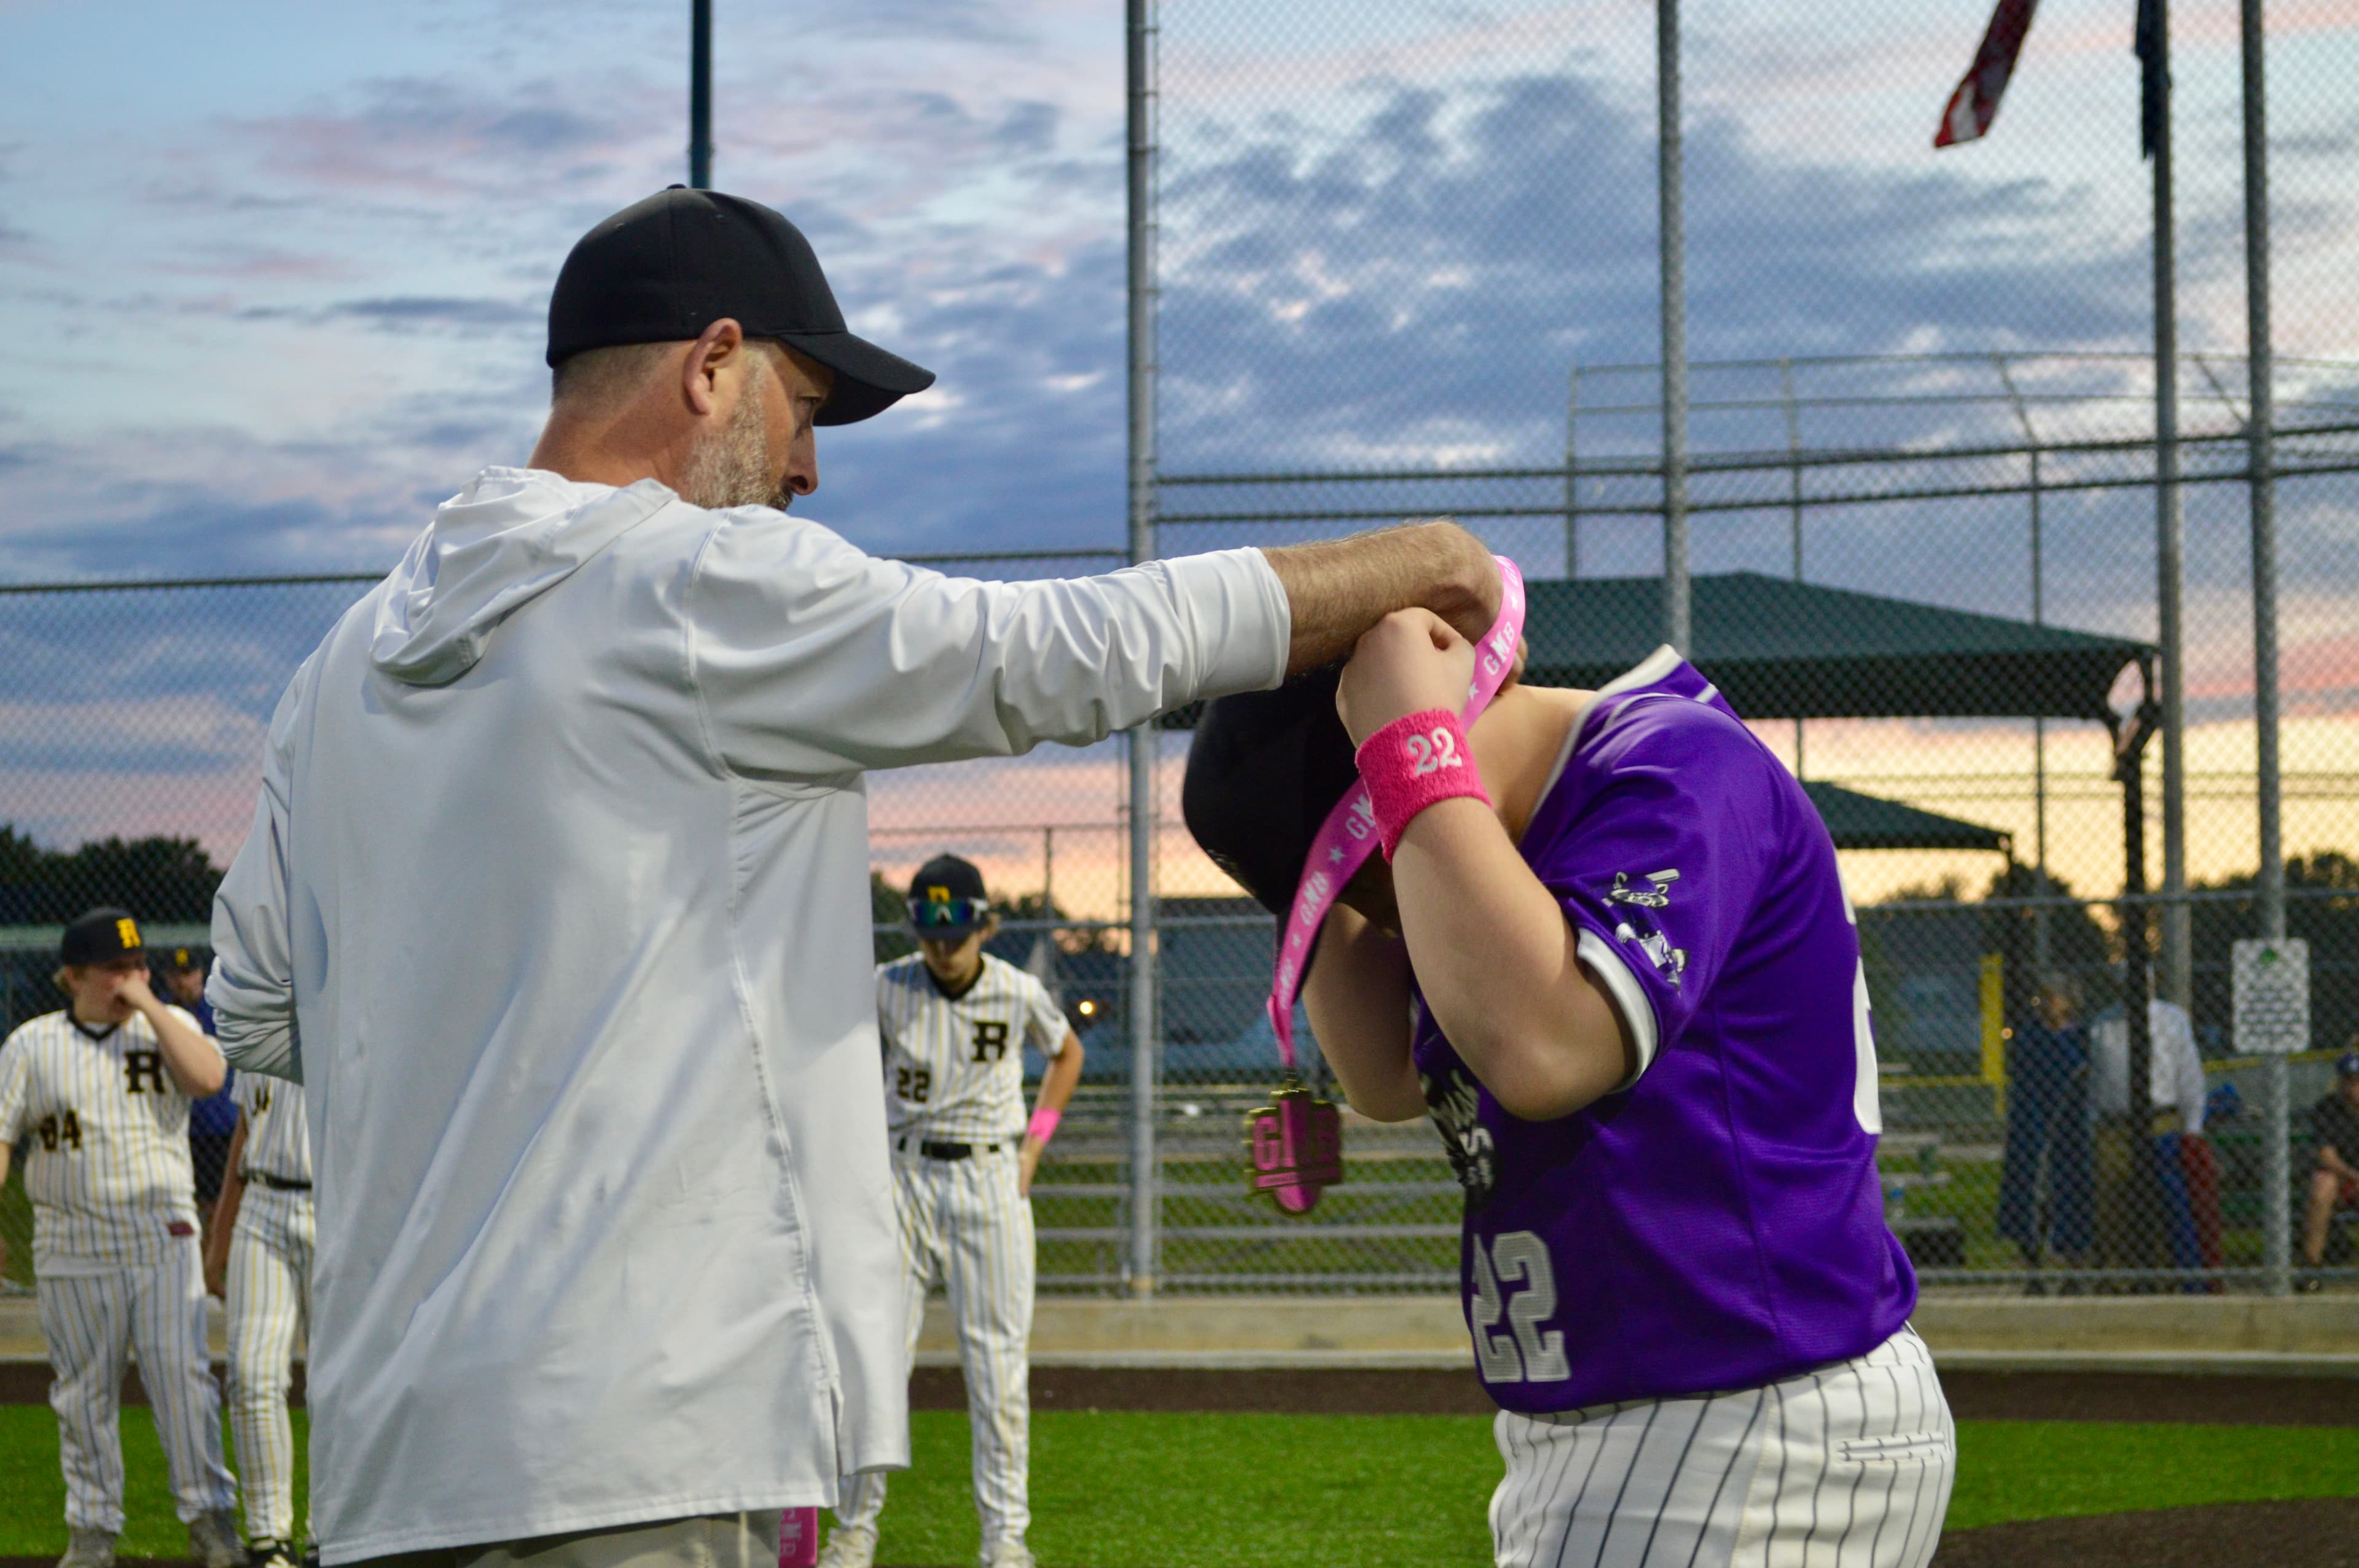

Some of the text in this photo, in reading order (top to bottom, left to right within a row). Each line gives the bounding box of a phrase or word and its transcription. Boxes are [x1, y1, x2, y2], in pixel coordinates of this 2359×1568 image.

[1483, 622, 1515, 676] GMB
[1407, 727, 1462, 777] 22
[1299, 870, 1329, 926] GMB
[116, 918, 141, 948] R
[971, 1020, 1008, 1063] R
[124, 1050, 165, 1094] R
[897, 1066, 930, 1103] 22
[1472, 1230, 1570, 1383] 22
